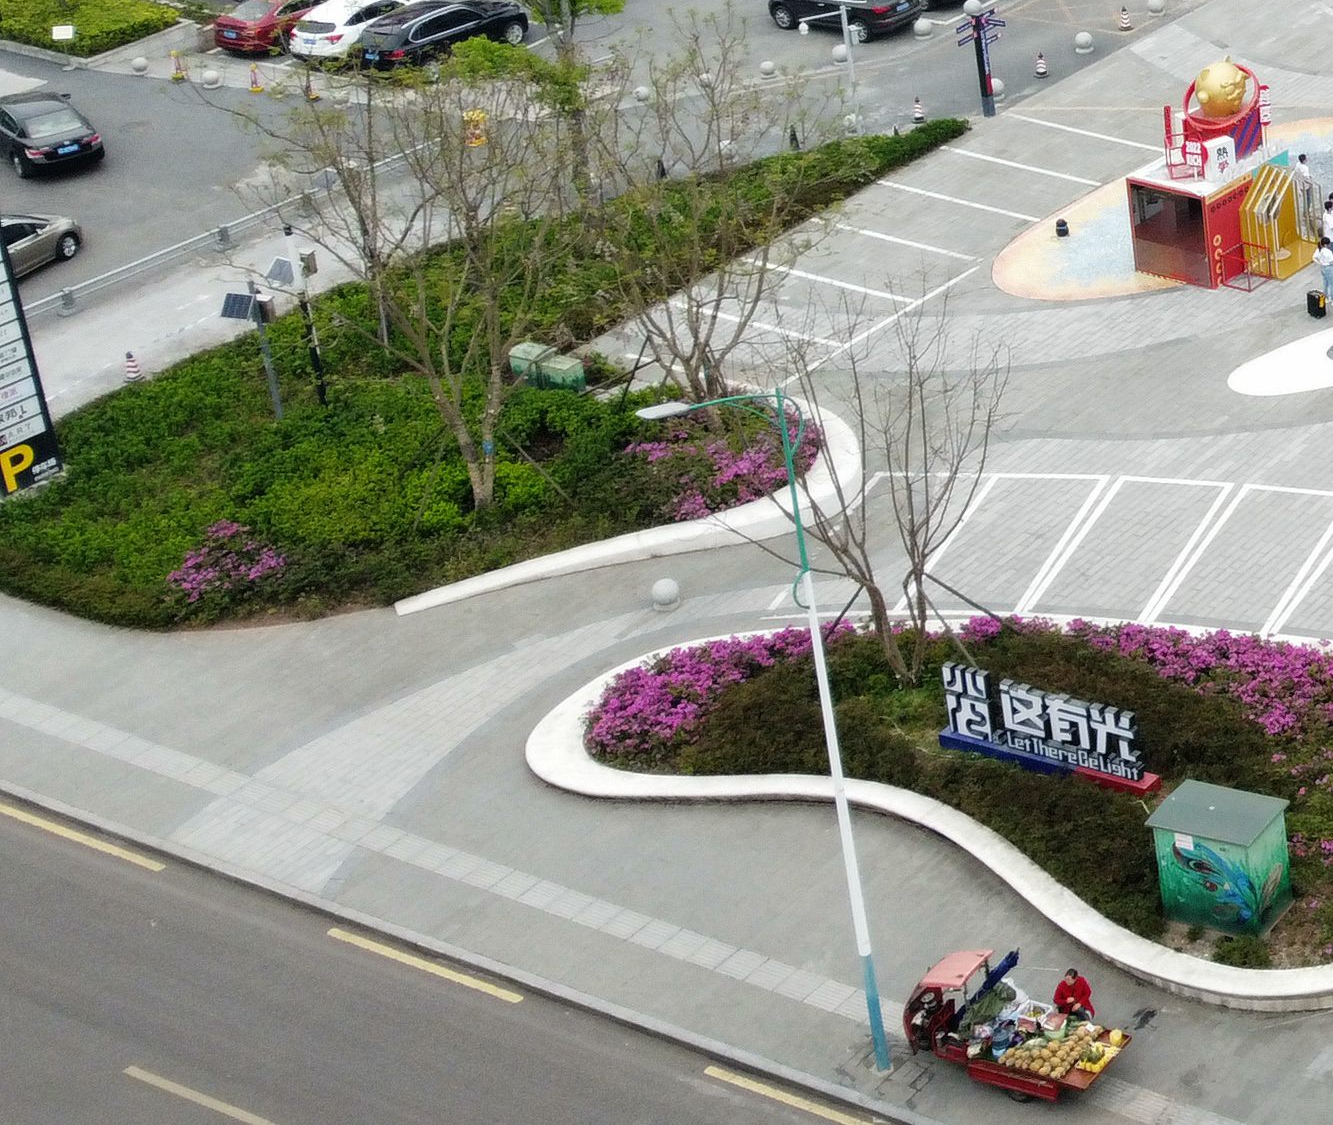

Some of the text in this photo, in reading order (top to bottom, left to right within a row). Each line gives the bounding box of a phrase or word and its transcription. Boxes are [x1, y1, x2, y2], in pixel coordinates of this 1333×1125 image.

[1, 444, 35, 493] P
[1000, 678, 1138, 763] 这有光
